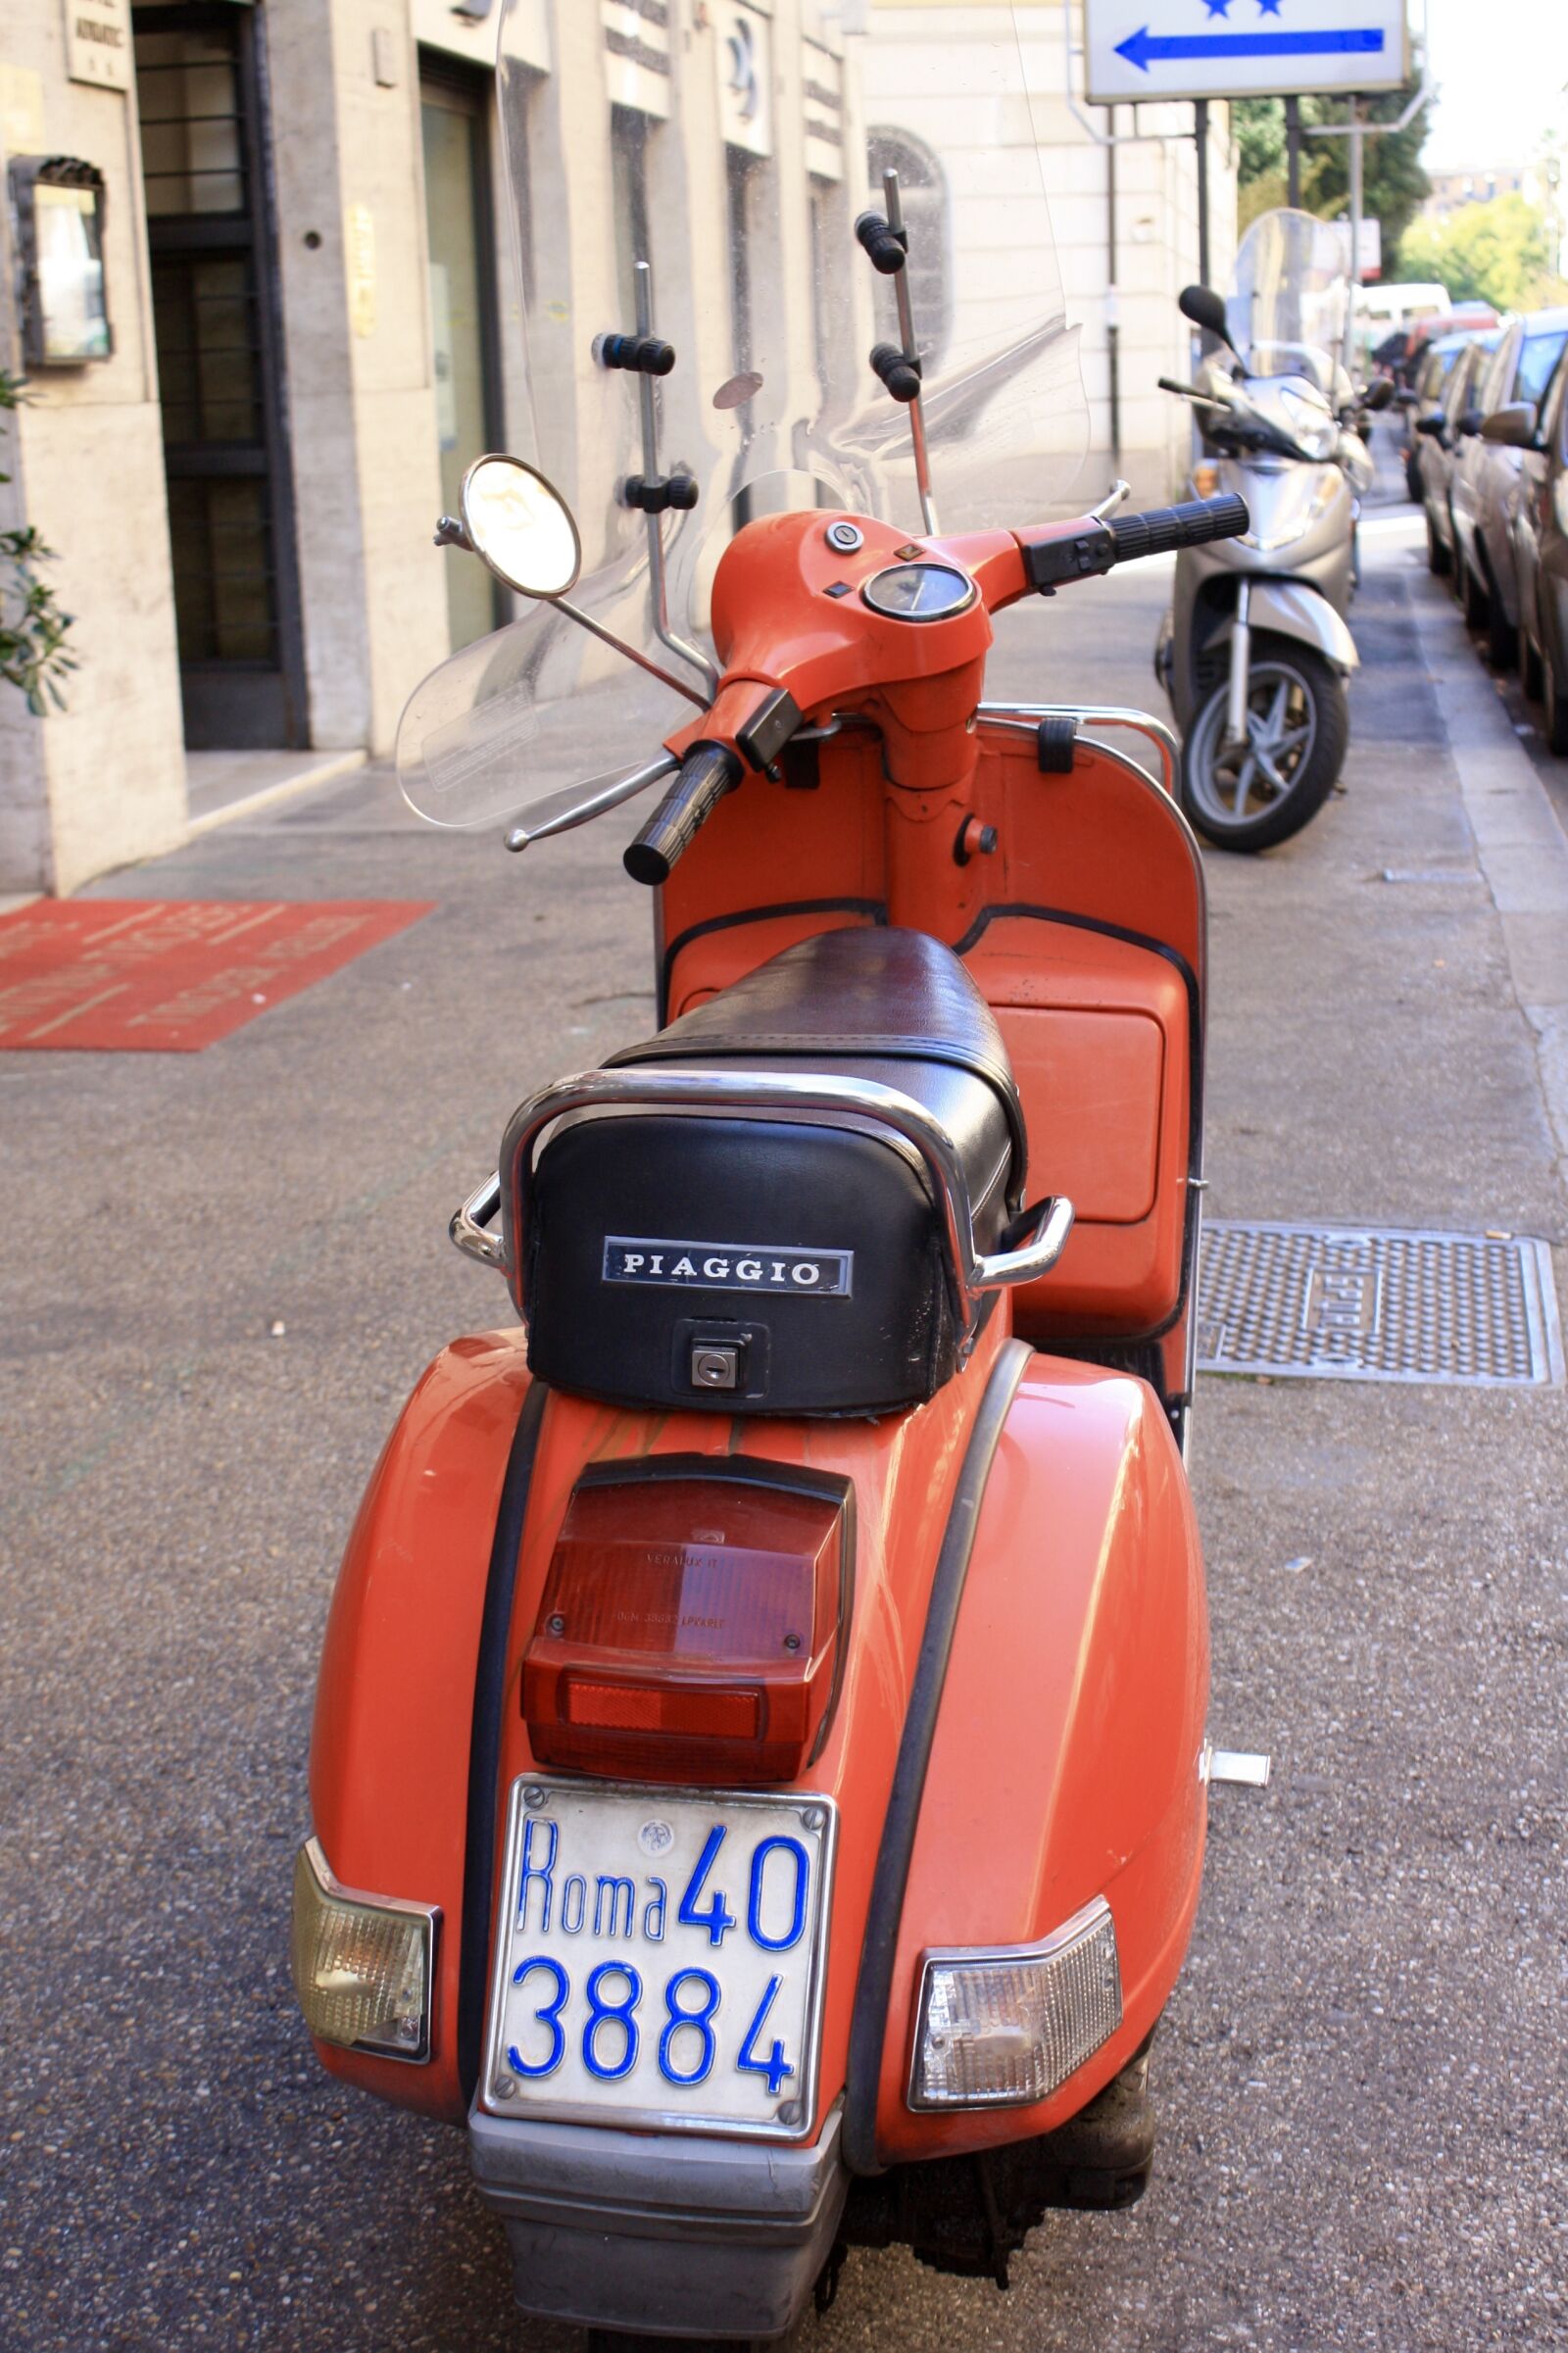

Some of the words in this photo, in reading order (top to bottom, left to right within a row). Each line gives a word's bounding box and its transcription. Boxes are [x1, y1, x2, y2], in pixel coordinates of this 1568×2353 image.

[623, 1253, 820, 1285] PIAGGIO
[517, 1818, 667, 1942] Roma
[678, 1825, 810, 1952] 40
[507, 1955, 795, 2094] 3884
